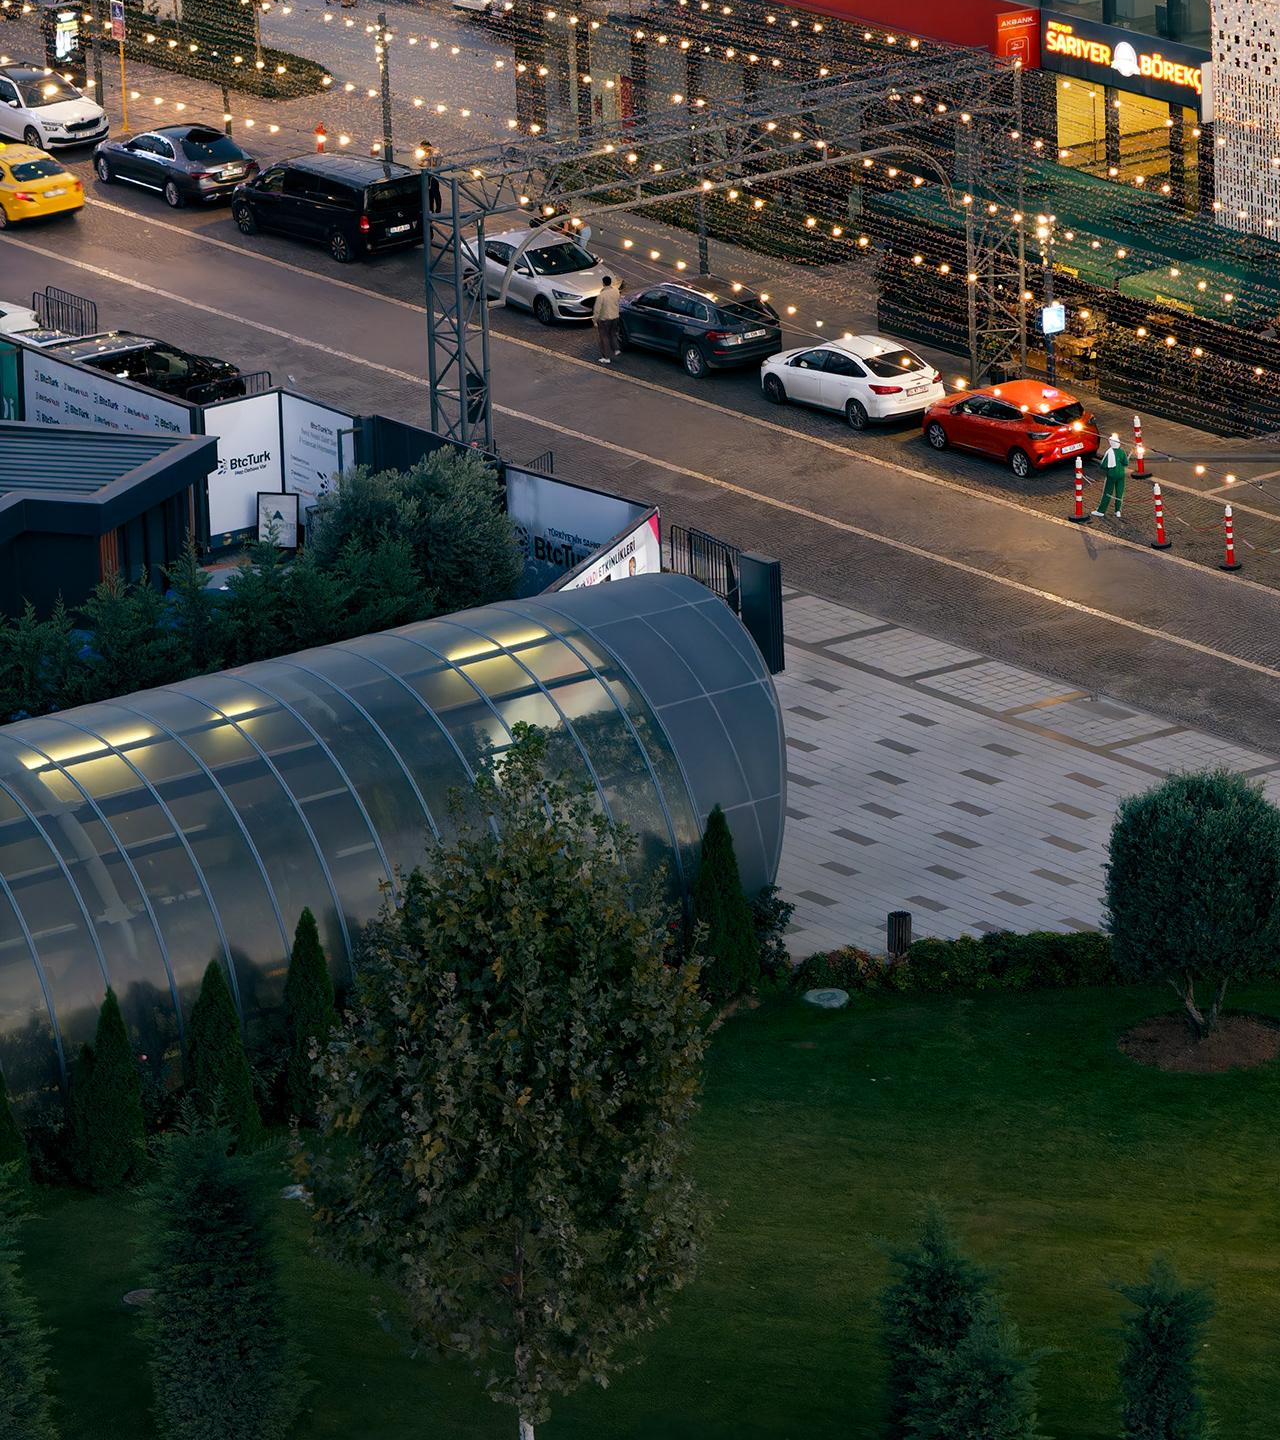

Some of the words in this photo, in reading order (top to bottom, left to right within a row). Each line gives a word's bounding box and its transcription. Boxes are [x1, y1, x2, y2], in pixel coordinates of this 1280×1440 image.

[1000, 16, 1034, 28] AKBANK
[1045, 30, 1112, 67] SARIYER
[230, 450, 271, 470] BtcTurk
